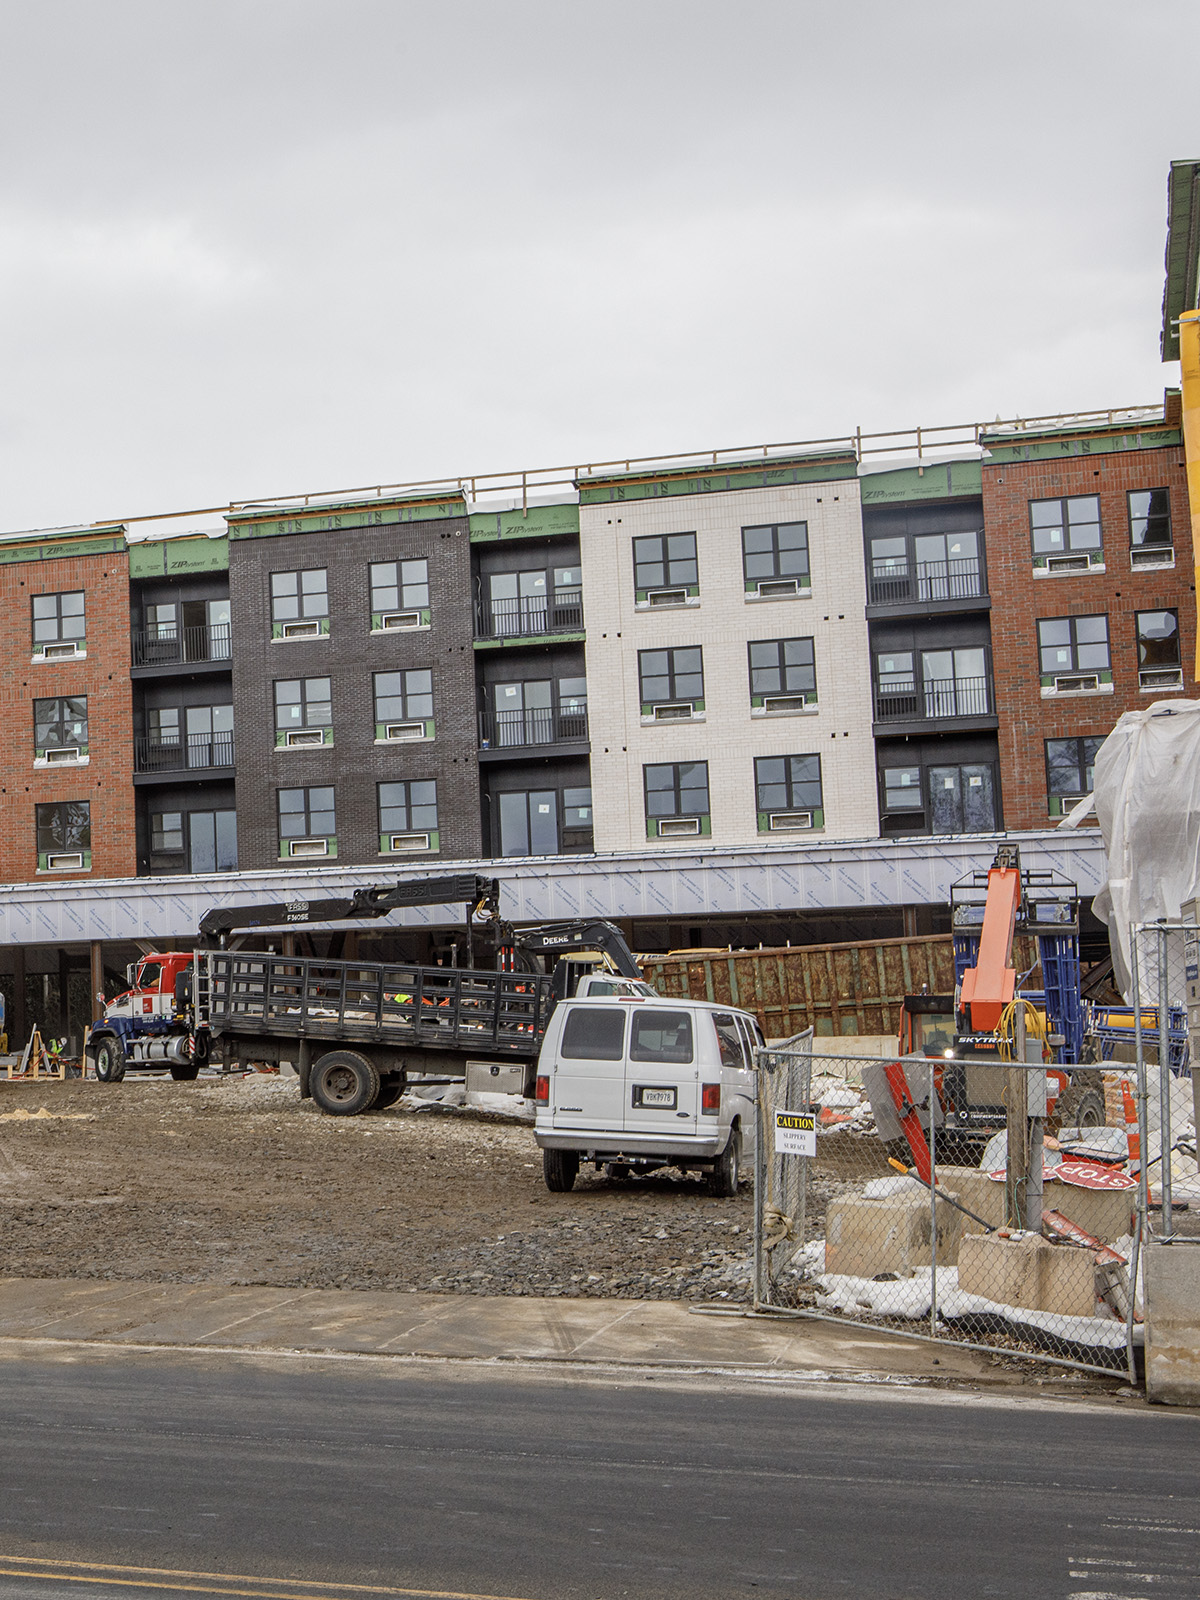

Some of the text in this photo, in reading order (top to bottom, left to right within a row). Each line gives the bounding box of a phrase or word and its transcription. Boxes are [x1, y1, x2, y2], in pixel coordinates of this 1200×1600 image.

[542, 934, 569, 946] DEERE
[958, 1036, 1014, 1044] SKYTRAK
[776, 1115, 814, 1129] CAUTION
[1060, 1165, 1130, 1187] STOP
